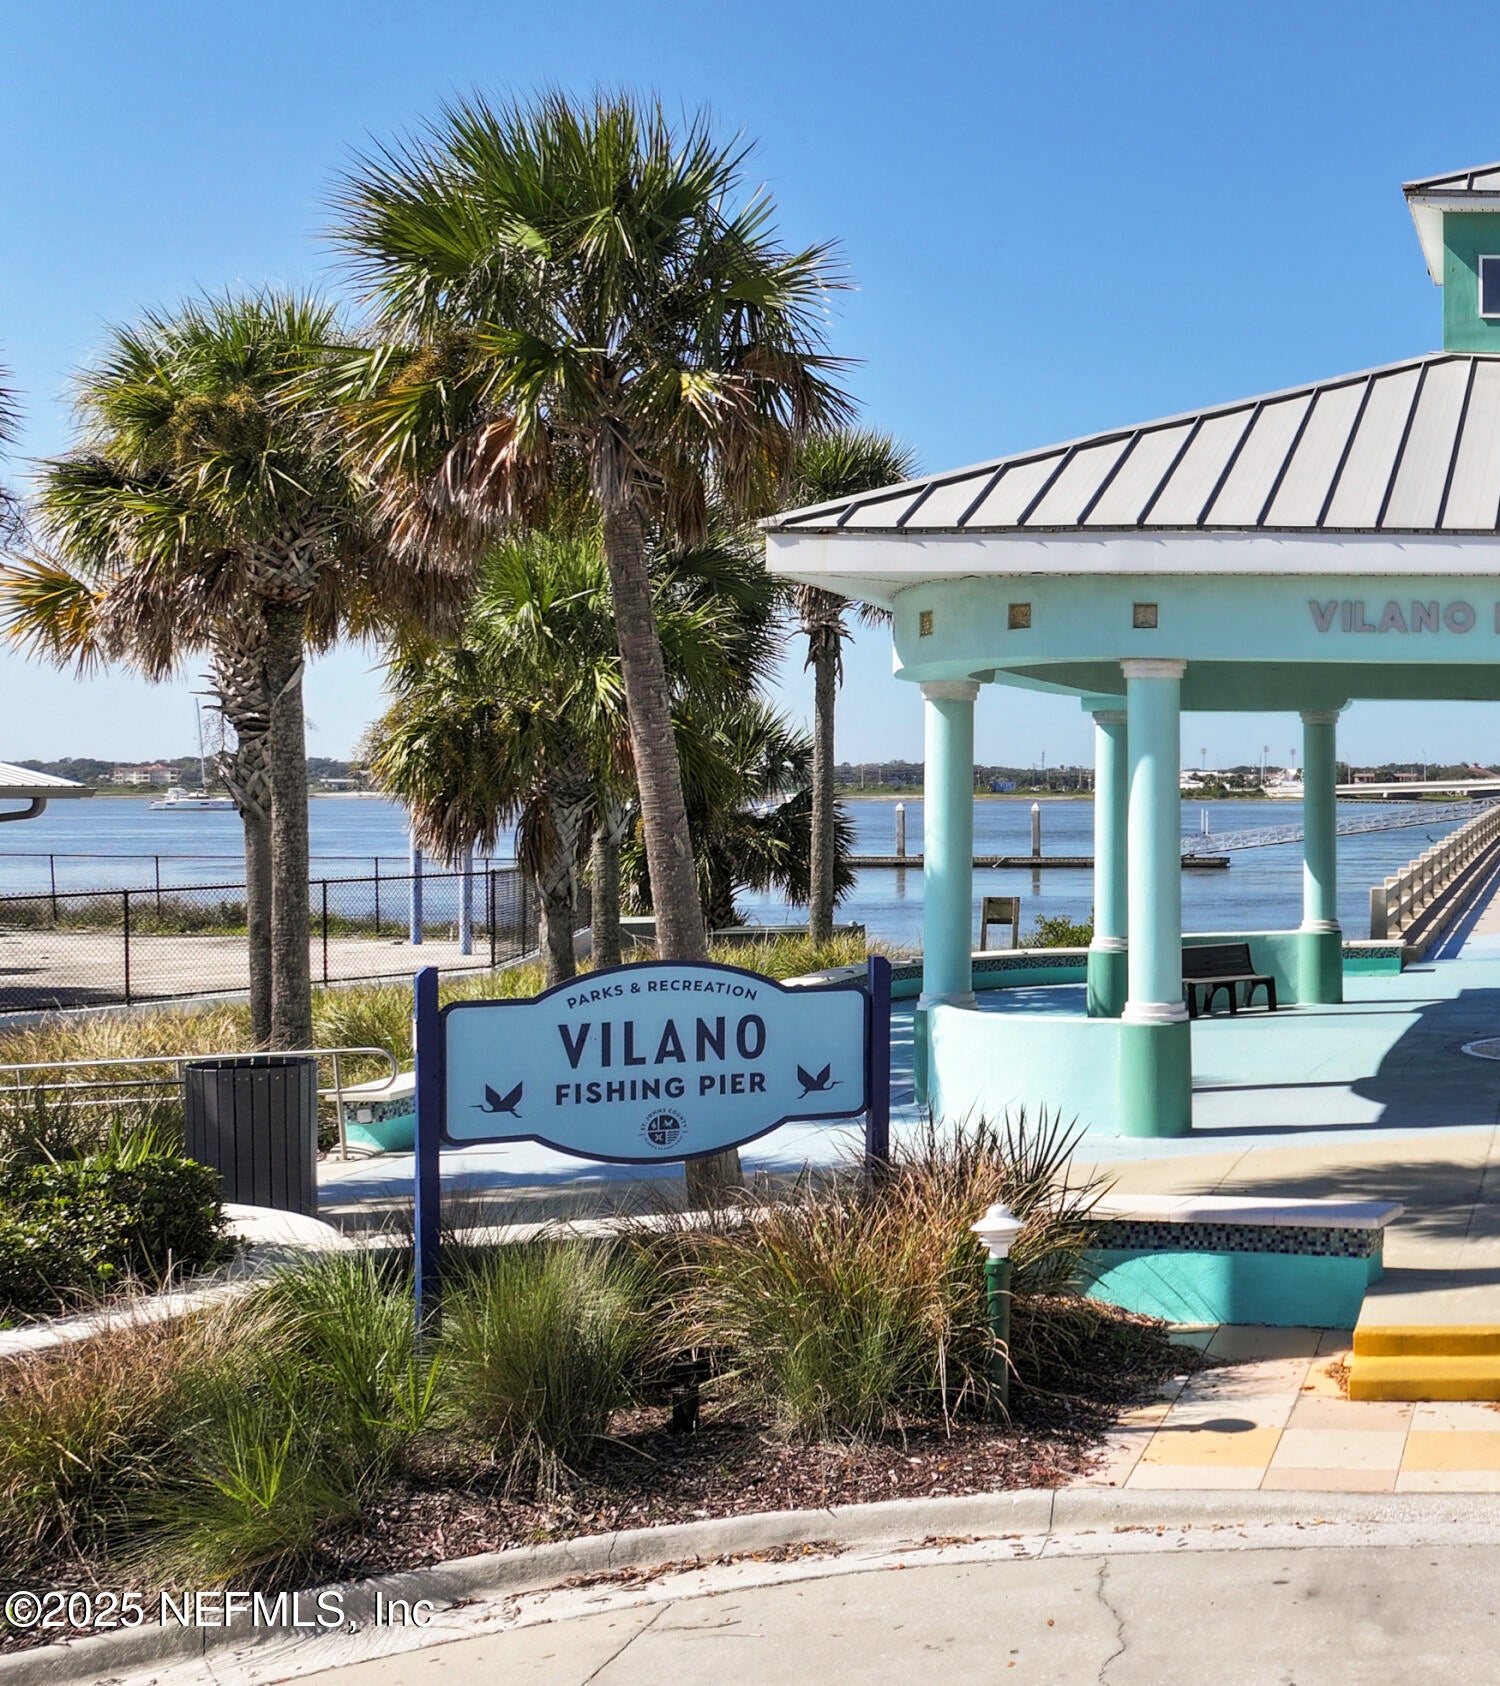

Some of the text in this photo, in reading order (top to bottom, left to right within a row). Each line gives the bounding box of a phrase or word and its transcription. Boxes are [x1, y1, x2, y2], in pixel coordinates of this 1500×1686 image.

[1308, 600, 1476, 634] VILANO
[567, 979, 758, 1009] PARKS & RECREATION
[557, 1014, 766, 1069] VILANO
[556, 1072, 766, 1106] FISHING PIER
